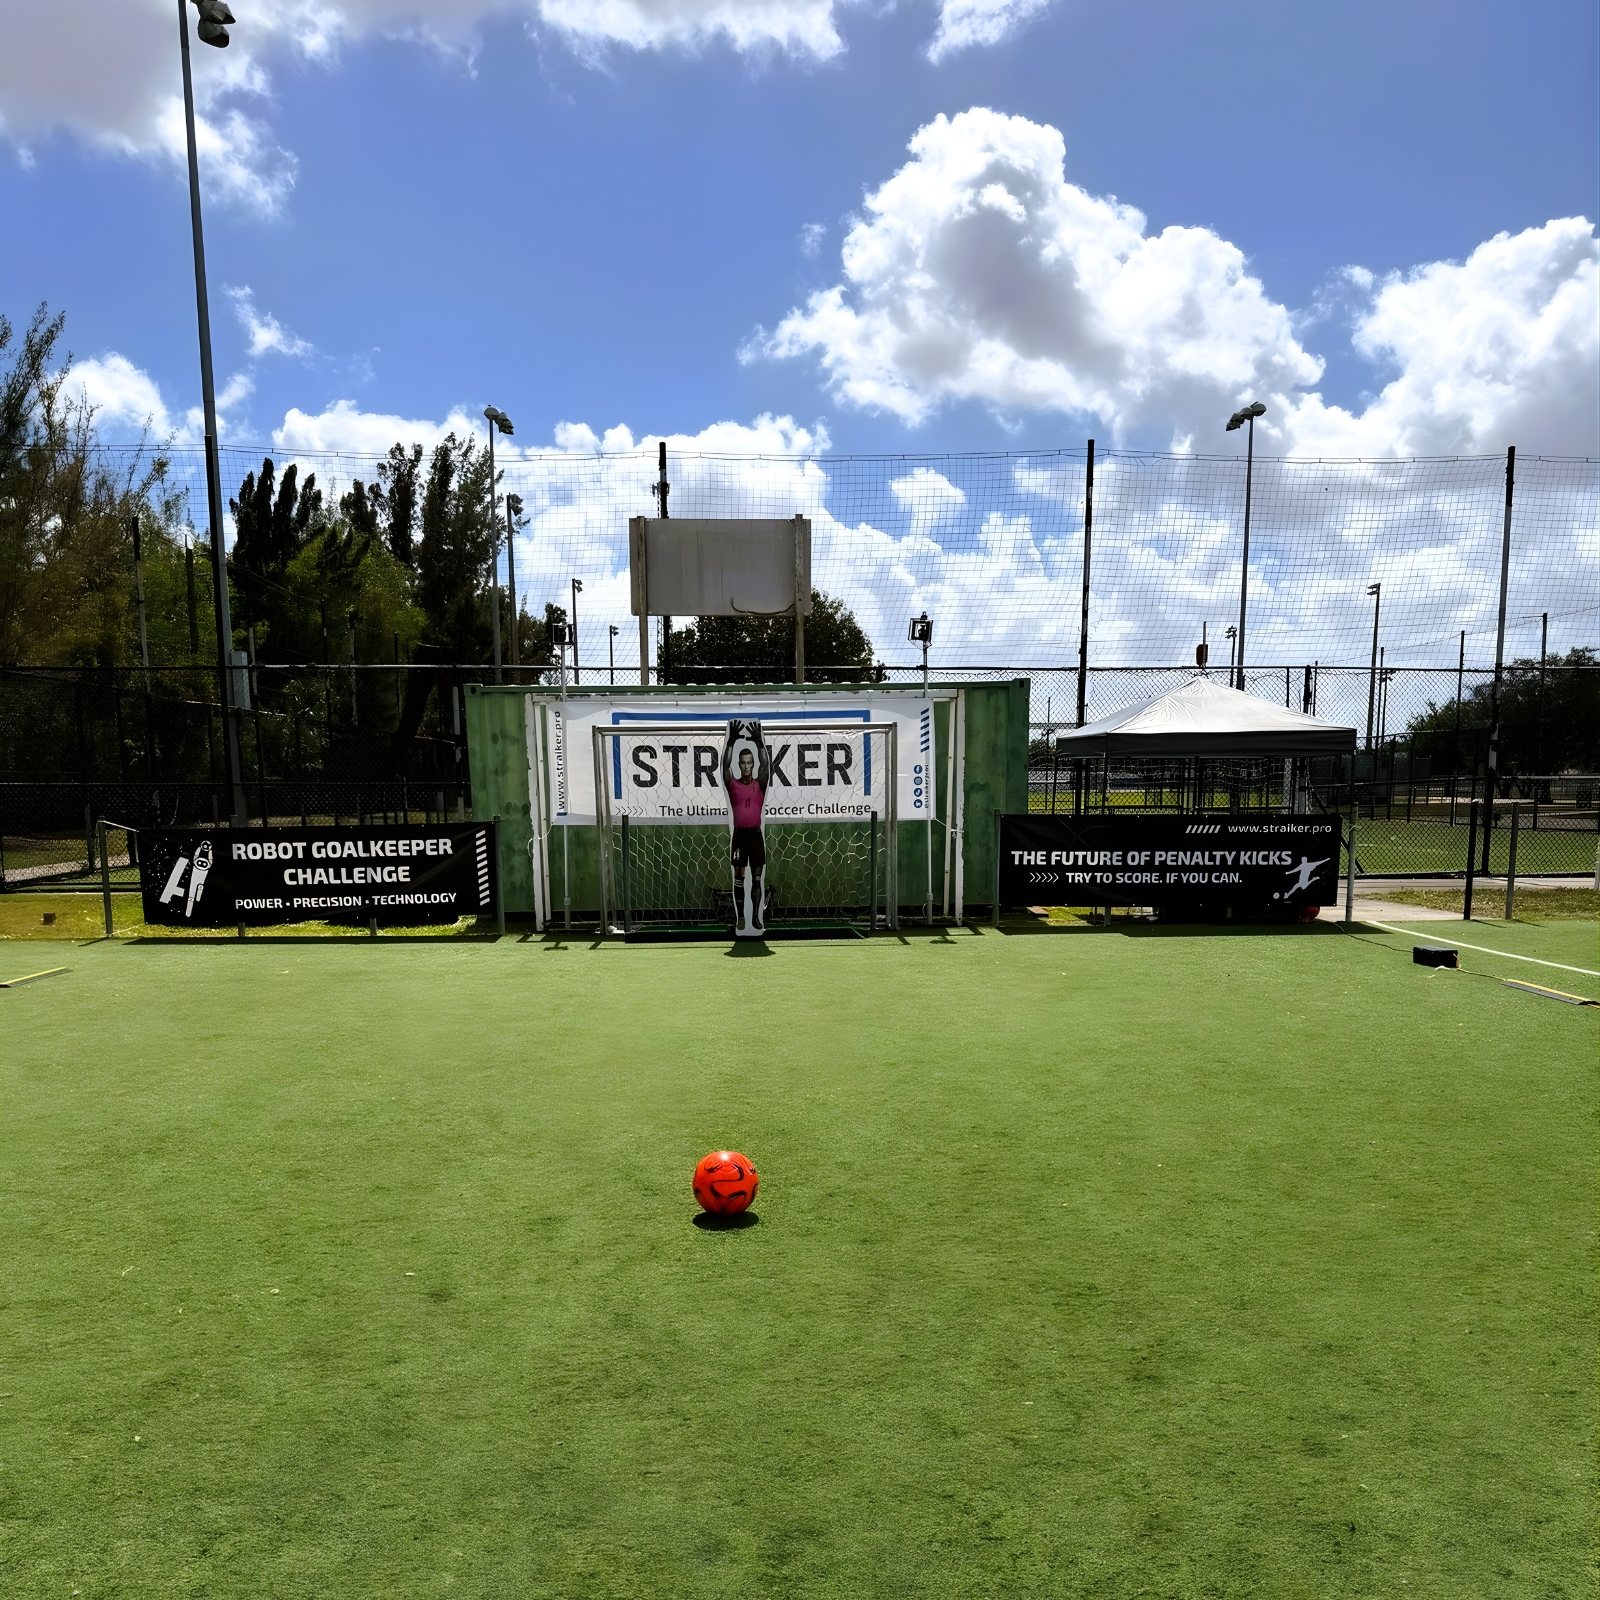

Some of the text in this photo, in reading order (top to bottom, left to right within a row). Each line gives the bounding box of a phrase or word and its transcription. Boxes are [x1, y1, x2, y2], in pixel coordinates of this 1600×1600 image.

[554, 711, 565, 810] www.straiker.pro
[632, 744, 852, 788] STRKER
[659, 805, 683, 816] The
[807, 803, 872, 817] Challenge
[1228, 824, 1332, 835] www.straiker.pro
[232, 838, 453, 860] ROBOT GOALKEEPER
[1011, 851, 1292, 865] THE FUTURE OF PENALTY KICKS
[284, 866, 411, 885] CHALLENGE
[1066, 872, 1242, 883] TRY TO SCORE. IF YOU CAN.
[235, 892, 457, 909] POWER PRECISION TECHNOLOGY
